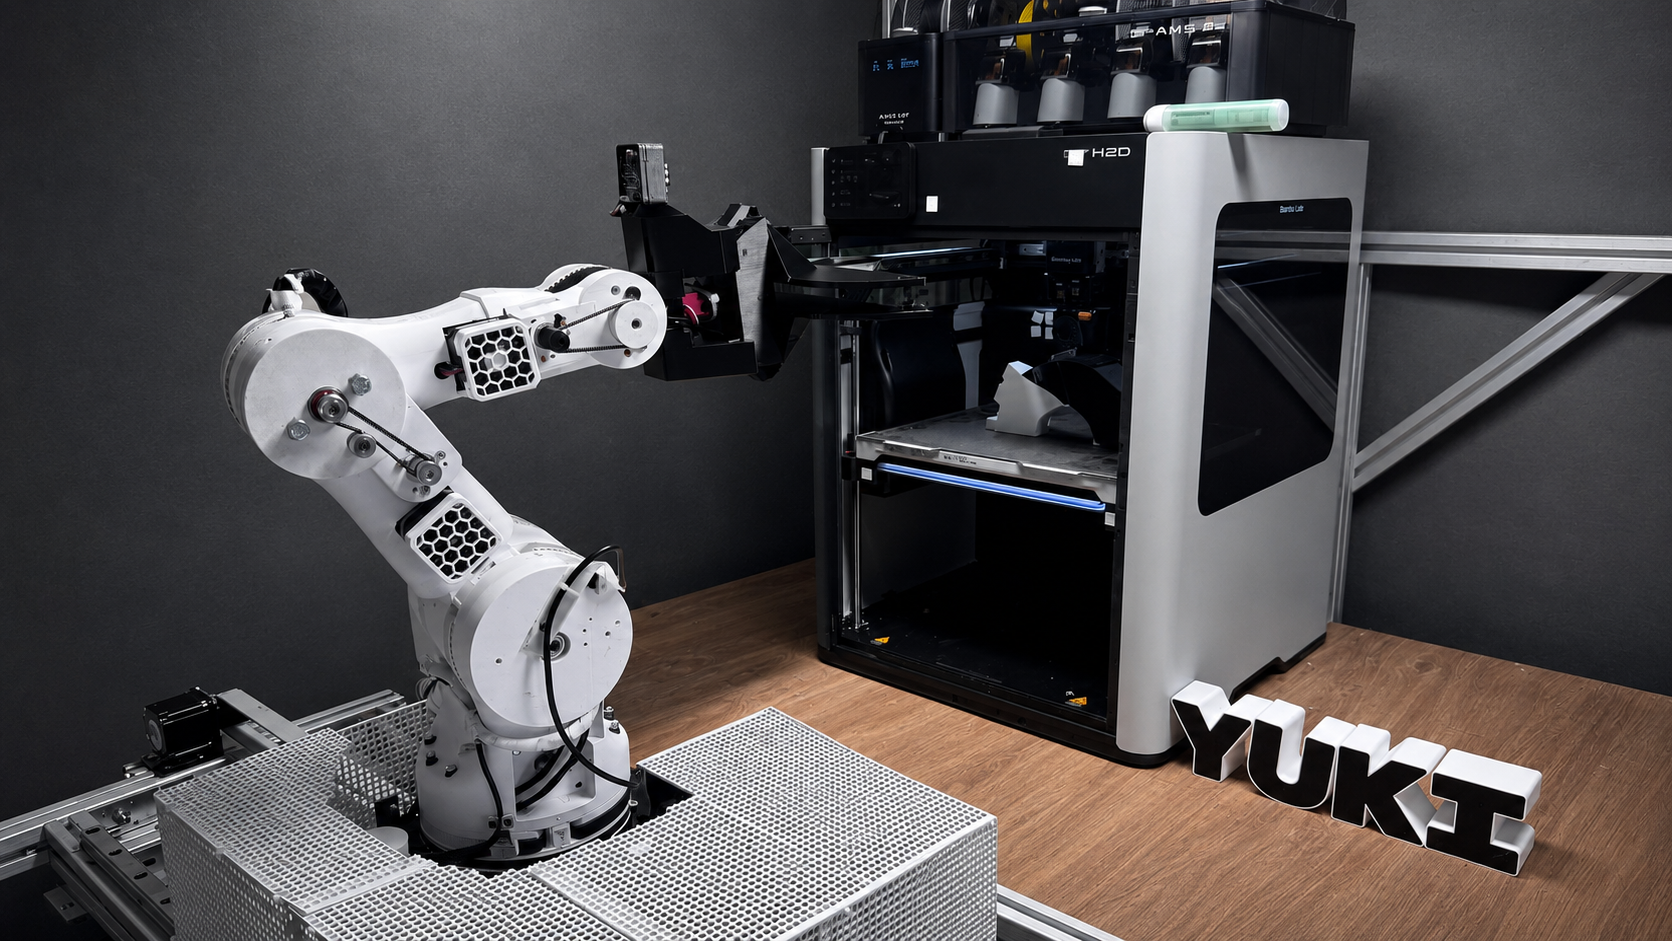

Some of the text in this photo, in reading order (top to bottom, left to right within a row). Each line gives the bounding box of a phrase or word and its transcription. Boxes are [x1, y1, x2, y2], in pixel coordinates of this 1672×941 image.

[1155, 23, 1196, 36] AMS
[1092, 146, 1131, 158] H2D
[1171, 696, 1528, 876] YUKI
